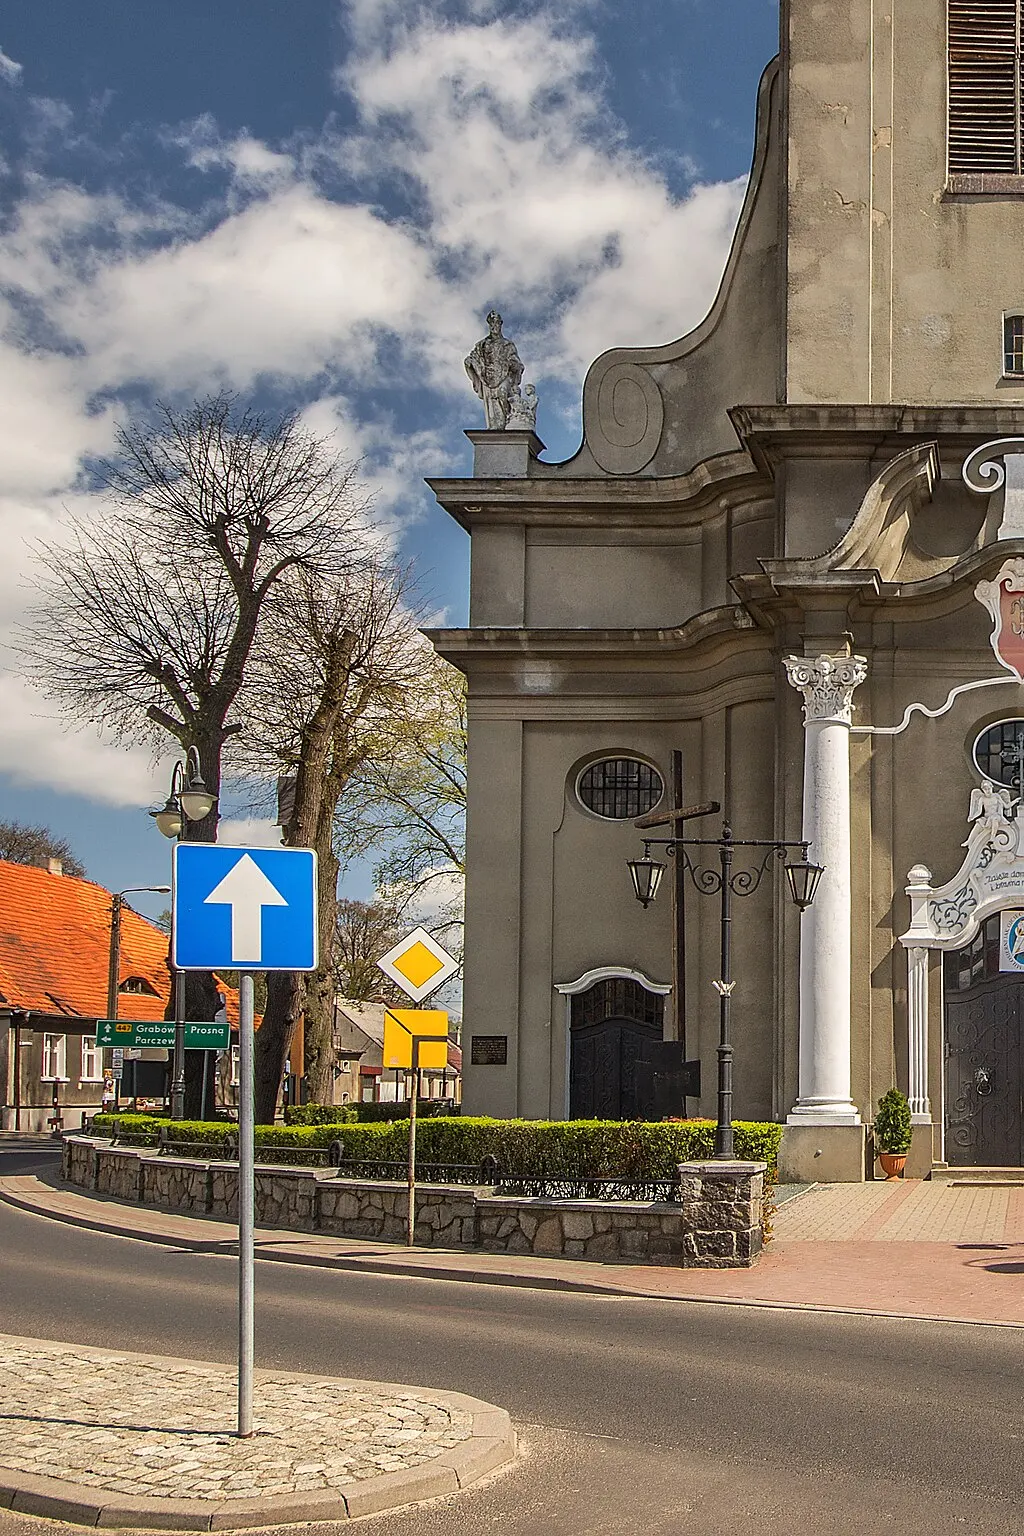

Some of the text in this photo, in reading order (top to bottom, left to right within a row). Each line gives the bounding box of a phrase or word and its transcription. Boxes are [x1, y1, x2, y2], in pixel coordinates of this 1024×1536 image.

[116, 1024, 132, 1032] 447
[136, 1024, 175, 1034] Grabów
[190, 1025, 224, 1037] Prosną
[135, 1036, 175, 1044] Parczew
